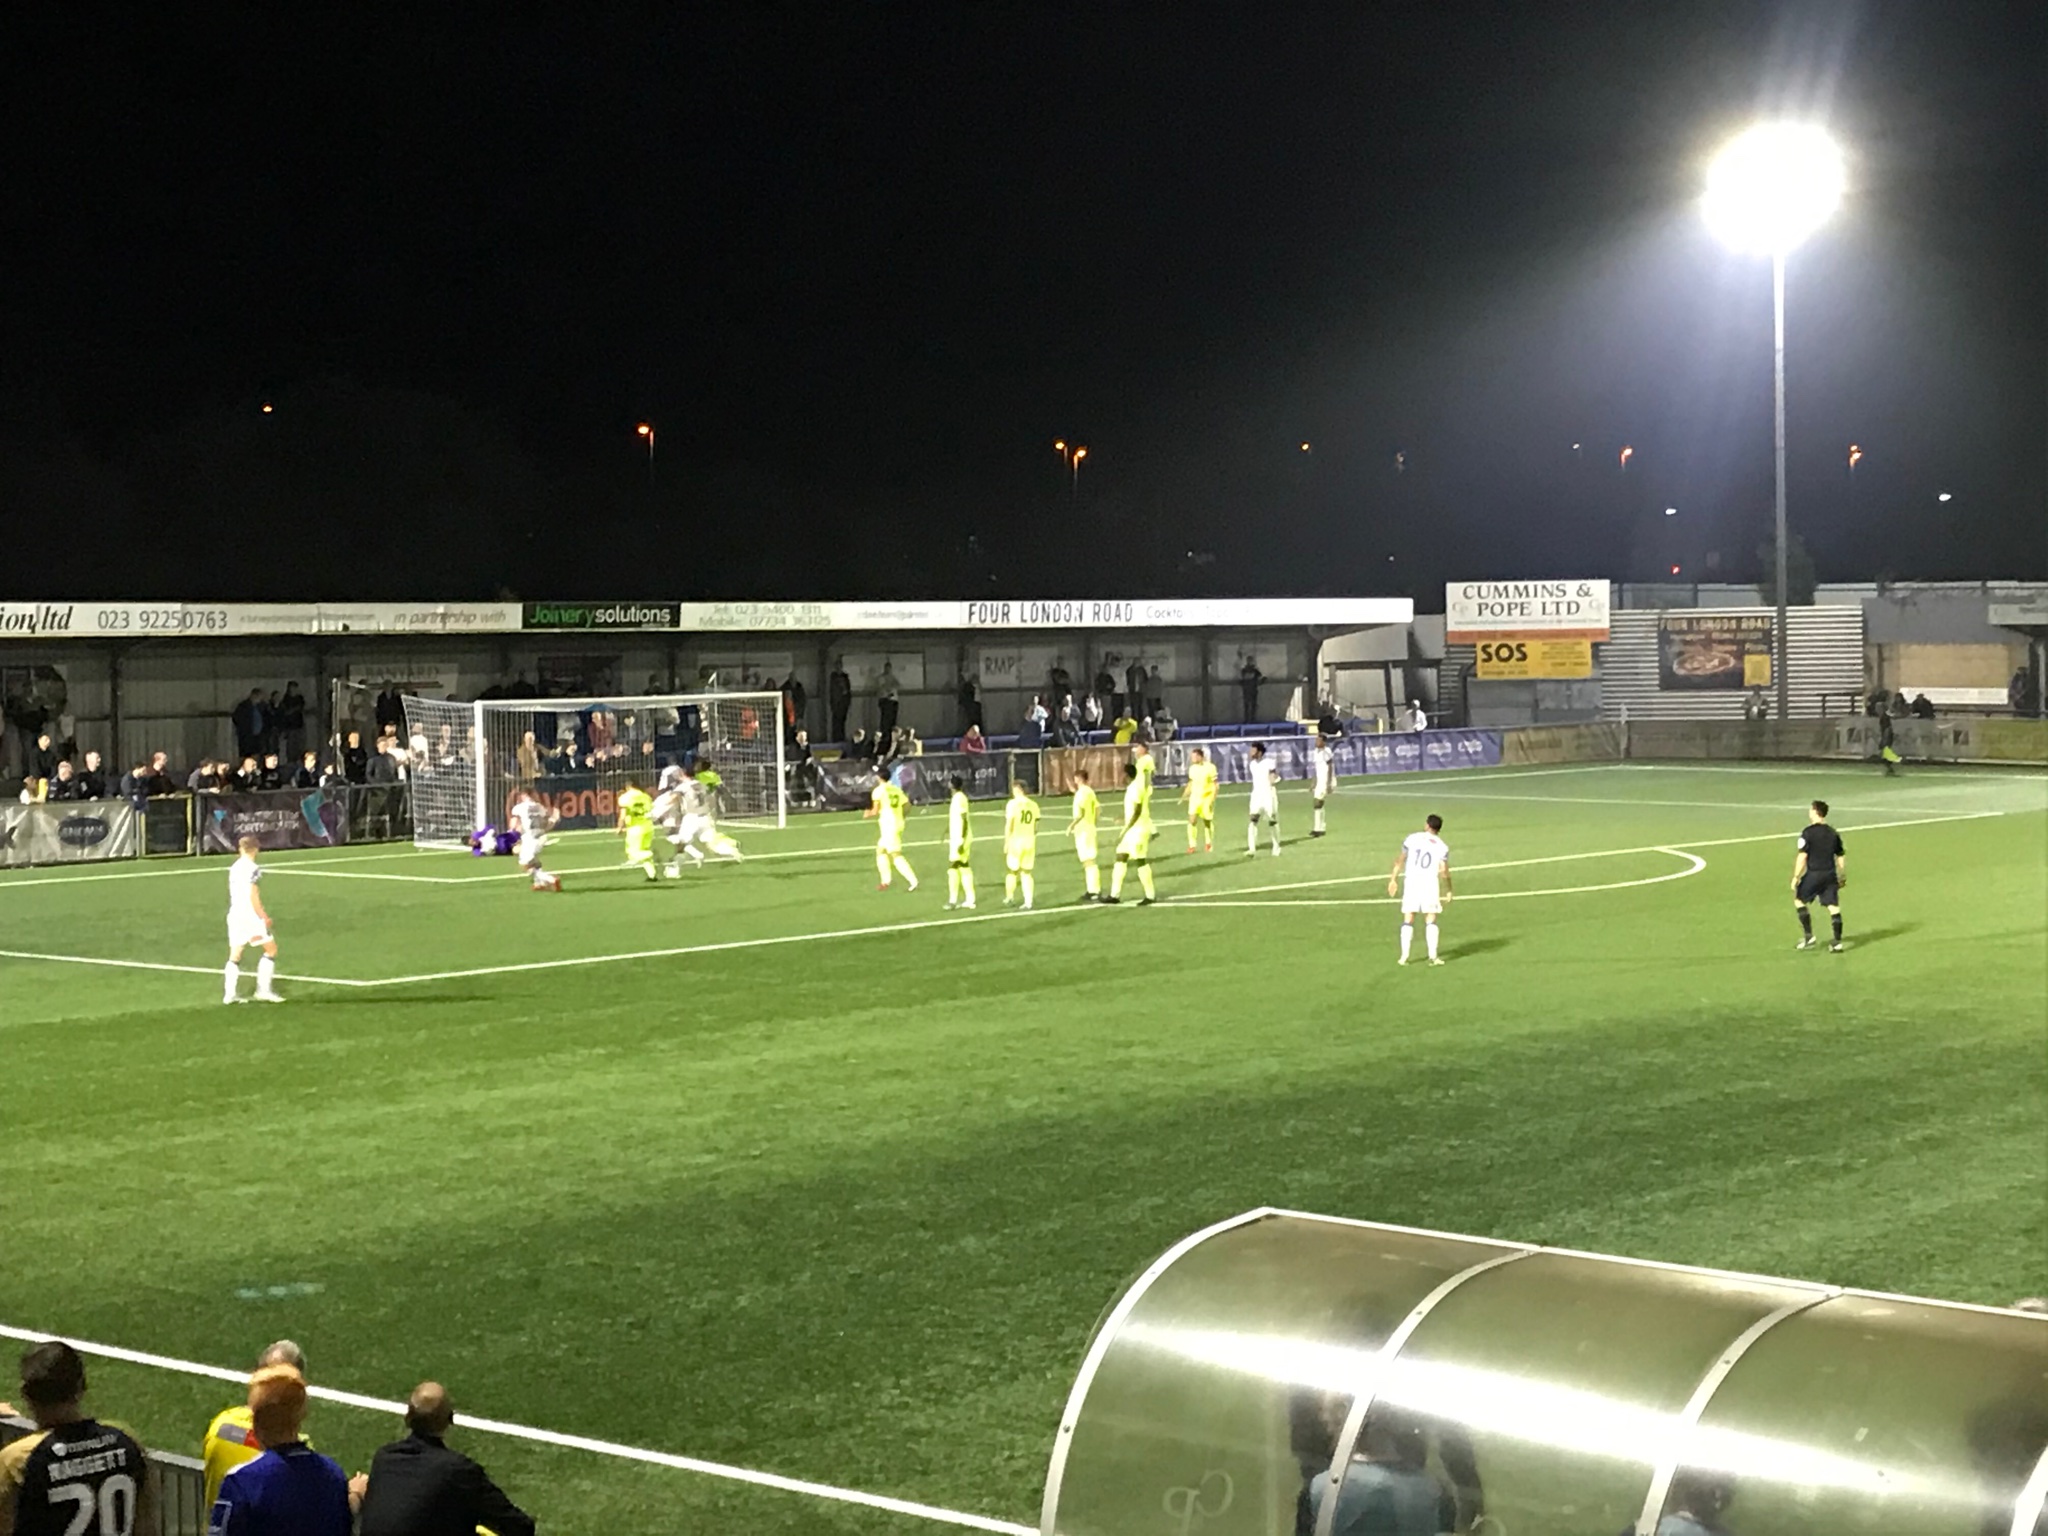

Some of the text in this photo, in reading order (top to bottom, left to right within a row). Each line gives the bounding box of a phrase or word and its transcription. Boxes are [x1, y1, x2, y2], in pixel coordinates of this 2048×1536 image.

[1463, 583, 1594, 600] CUMMINS &
[41, 605, 73, 631] ltd
[968, 602, 1133, 624] FOUR LONDON ROAD
[1476, 600, 1581, 617] POPE LTD
[97, 610, 130, 630] 023
[1480, 642, 1528, 663] SOS
[1020, 809, 1033, 825] 10
[1414, 848, 1432, 870] 10
